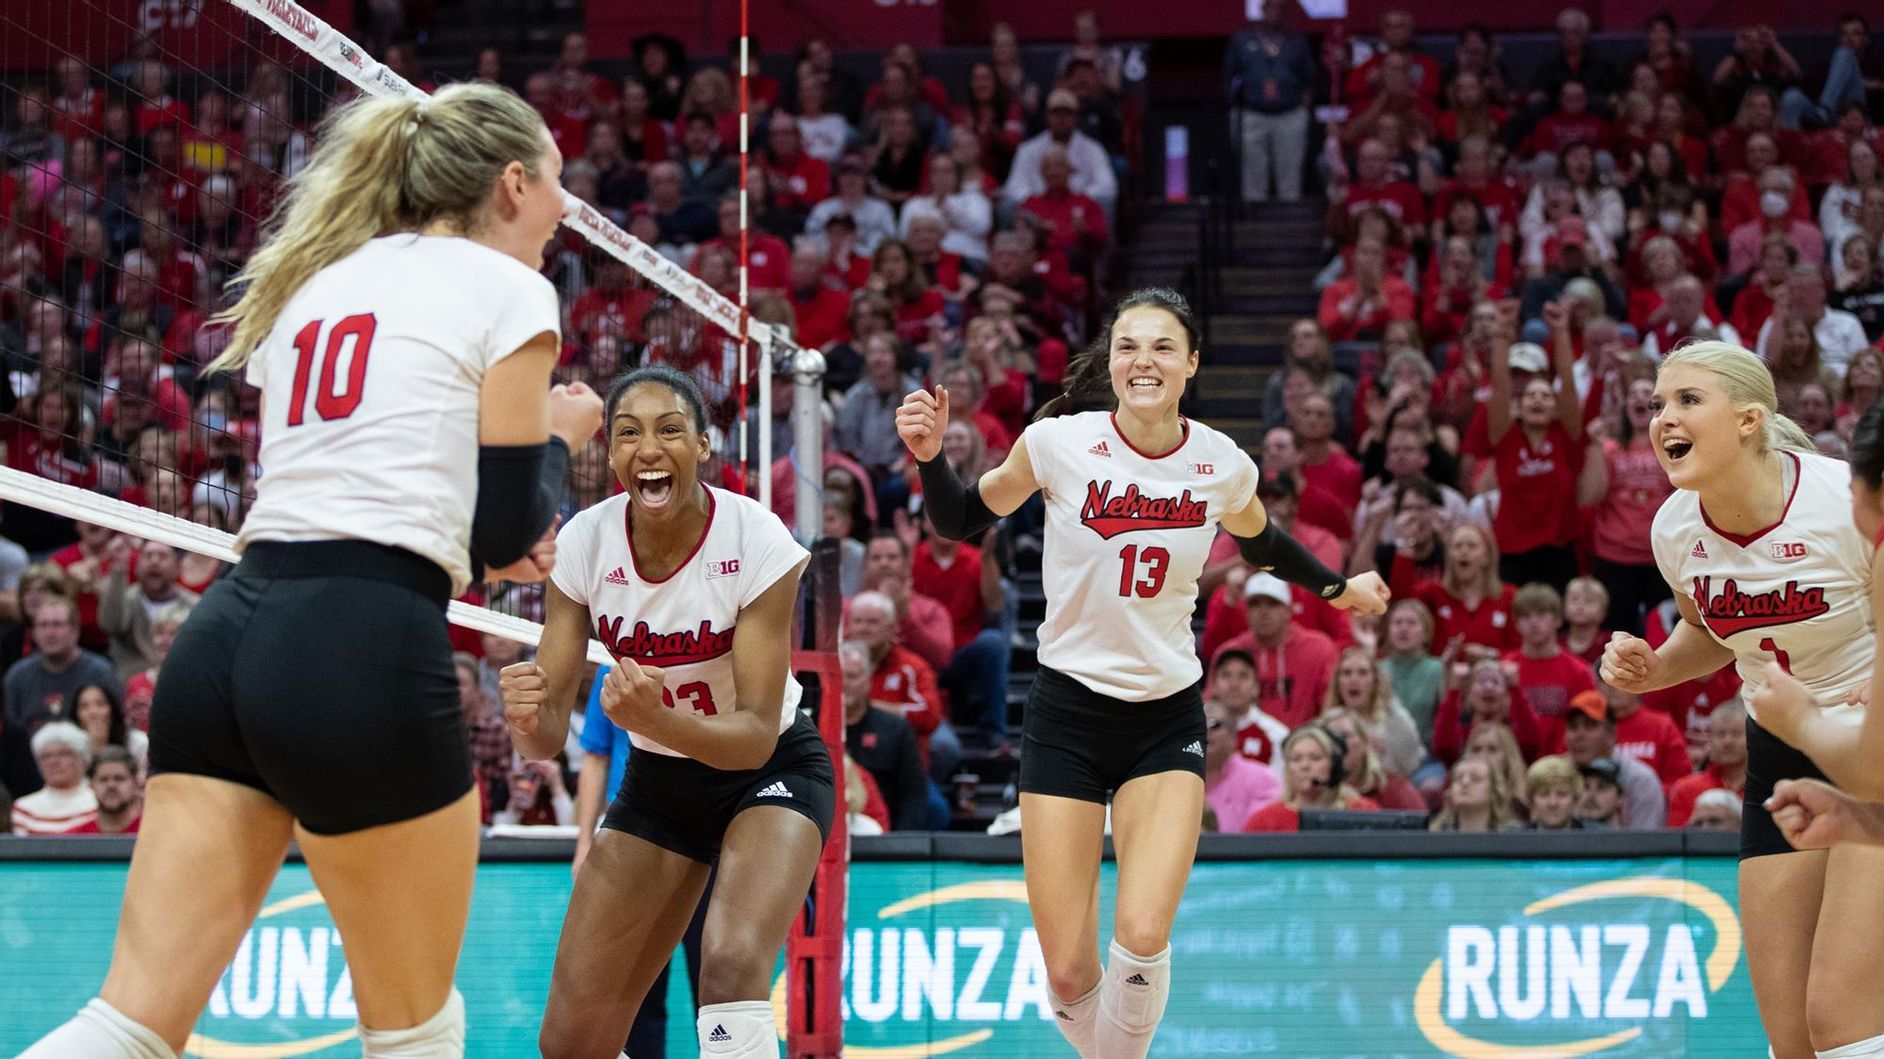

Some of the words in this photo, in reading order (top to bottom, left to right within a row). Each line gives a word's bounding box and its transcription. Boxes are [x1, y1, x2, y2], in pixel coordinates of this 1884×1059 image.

[287, 312, 377, 427] 10
[1088, 448, 1112, 458] adidas
[1080, 480, 1207, 525] Nebraska
[1119, 544, 1170, 598] 13
[1691, 550, 1709, 559] adidas
[604, 575, 629, 586] adidas
[1694, 575, 1830, 618] Nebraska
[599, 615, 736, 659] Nebraska
[662, 680, 718, 716] 3
[757, 788, 793, 798] adidas
[1447, 924, 1708, 1019] RUNZA
[708, 1034, 732, 1042] adidas
